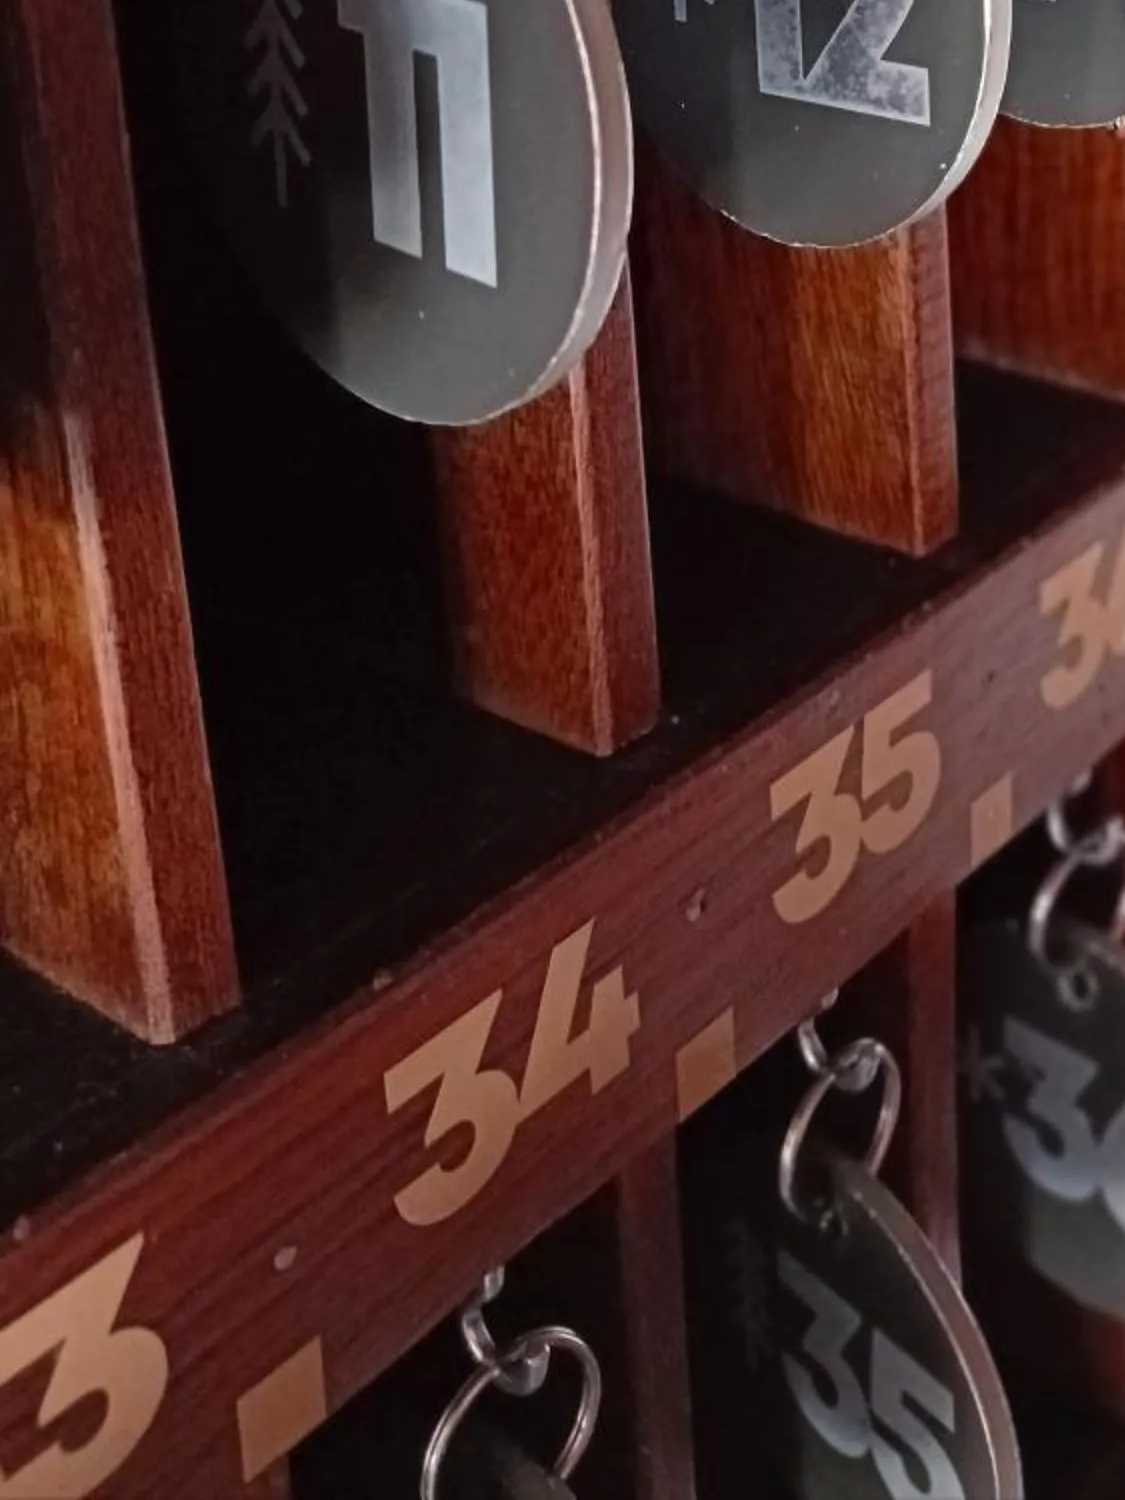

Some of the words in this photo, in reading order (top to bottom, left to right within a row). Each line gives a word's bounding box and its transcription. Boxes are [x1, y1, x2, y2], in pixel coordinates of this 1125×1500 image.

[768, 668, 942, 924] 35
[383, 917, 641, 1227] 34
[775, 1245, 967, 1500] 35
